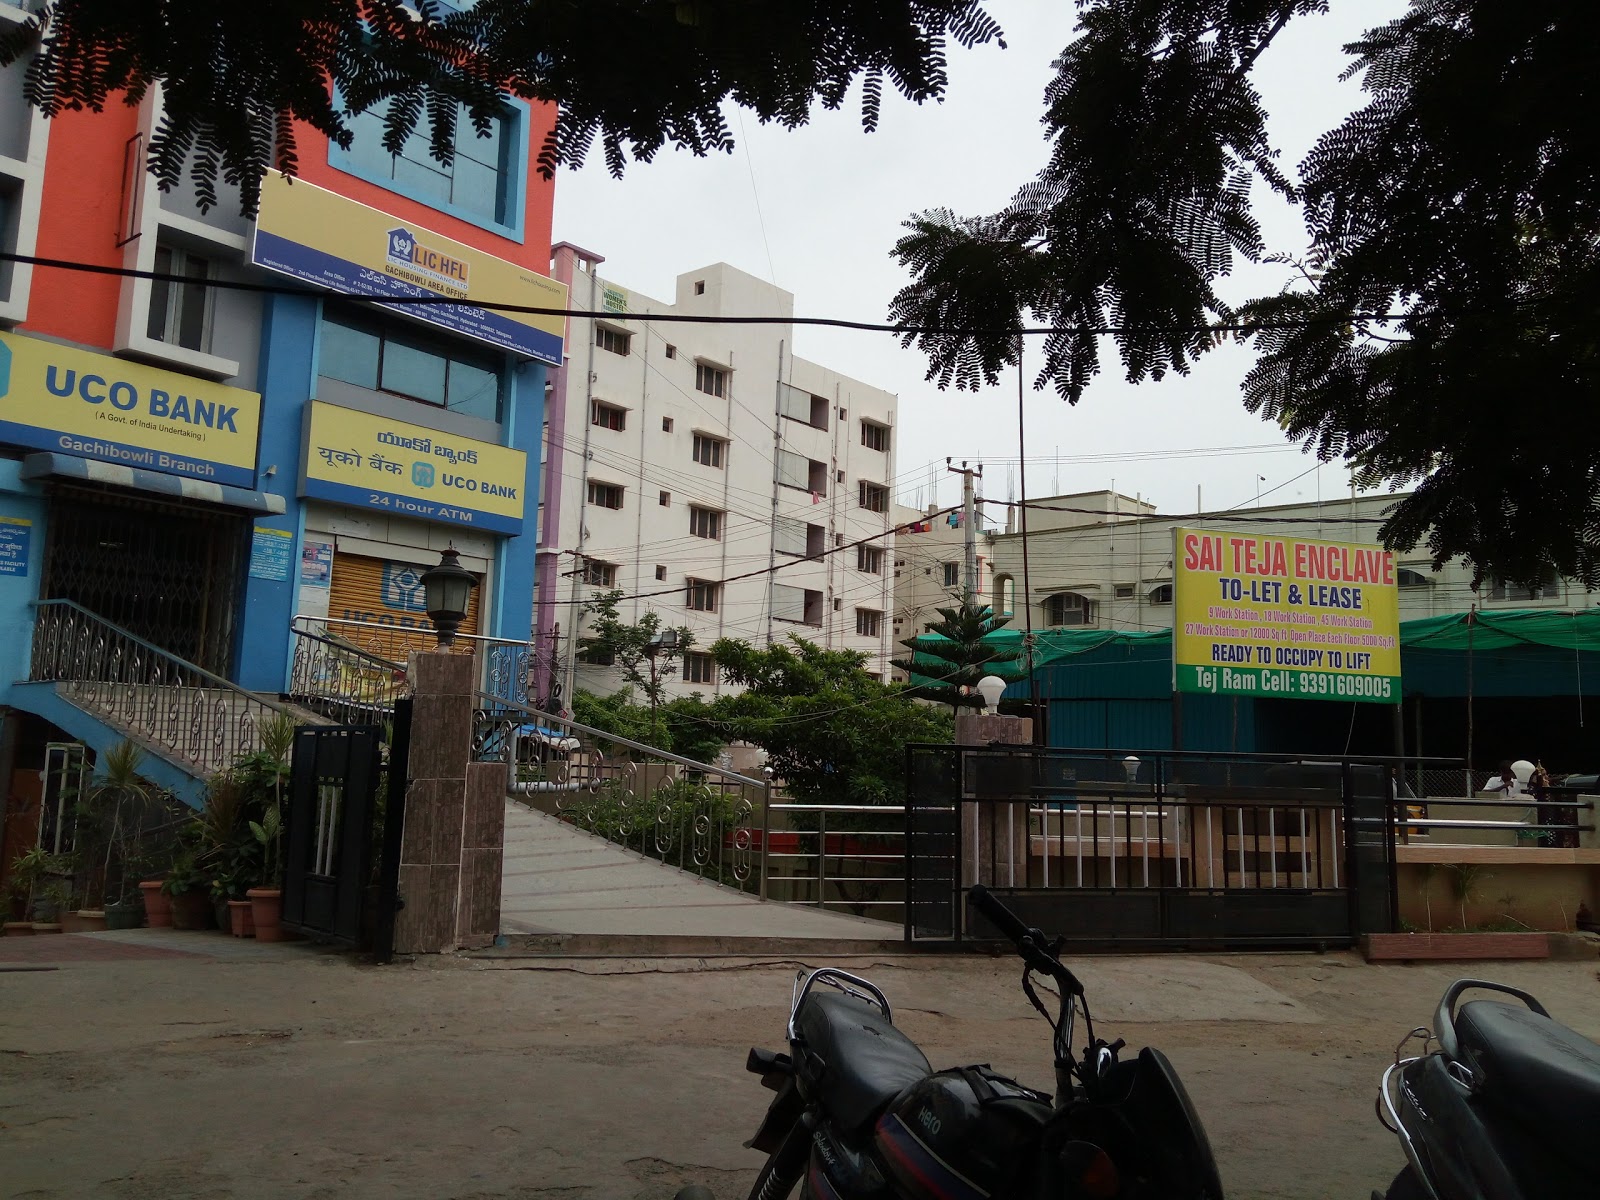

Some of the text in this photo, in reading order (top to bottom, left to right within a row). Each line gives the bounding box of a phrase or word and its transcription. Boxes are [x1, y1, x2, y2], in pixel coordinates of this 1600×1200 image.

[387, 256, 397, 264] LIC
[400, 261, 428, 275] HOUSING
[429, 272, 456, 286] FINANCE
[414, 247, 437, 269] LIC
[440, 257, 466, 281] HFL
[385, 264, 468, 300] GACHIBOWLI AREA OFFICE
[45, 364, 239, 434] UCO BANK
[107, 413, 128, 424] Govt.
[139, 420, 157, 431] India
[159, 424, 202, 441] Undertaking
[58, 435, 215, 476] Gachibowli Branch
[377, 432, 432, 454] యూకో
[317, 446, 404, 476] यूको बैंक
[442, 473, 517, 500] UCO BANK
[369, 494, 473, 522] 24 hour ATM
[1184, 534, 1394, 585] SAI TEJA ENCLAVE
[1219, 578, 1362, 609] TO-LET & LEASE
[1209, 606, 1214, 618] 9
[1215, 606, 1233, 619] Work
[1264, 611, 1272, 622] 18
[1273, 611, 1291, 623] Work
[1321, 614, 1329, 626] 45
[1331, 615, 1348, 627] Work
[1349, 616, 1373, 629] Station
[1185, 623, 1395, 650] 27 Work Station or 12000 Sq ft Open Place Each Floor 5000 Sq.Ft
[1212, 643, 1371, 670] READY TO OCCUPY TO LIFT
[1195, 666, 1392, 698] Tej Ram Cell: 9391609005
